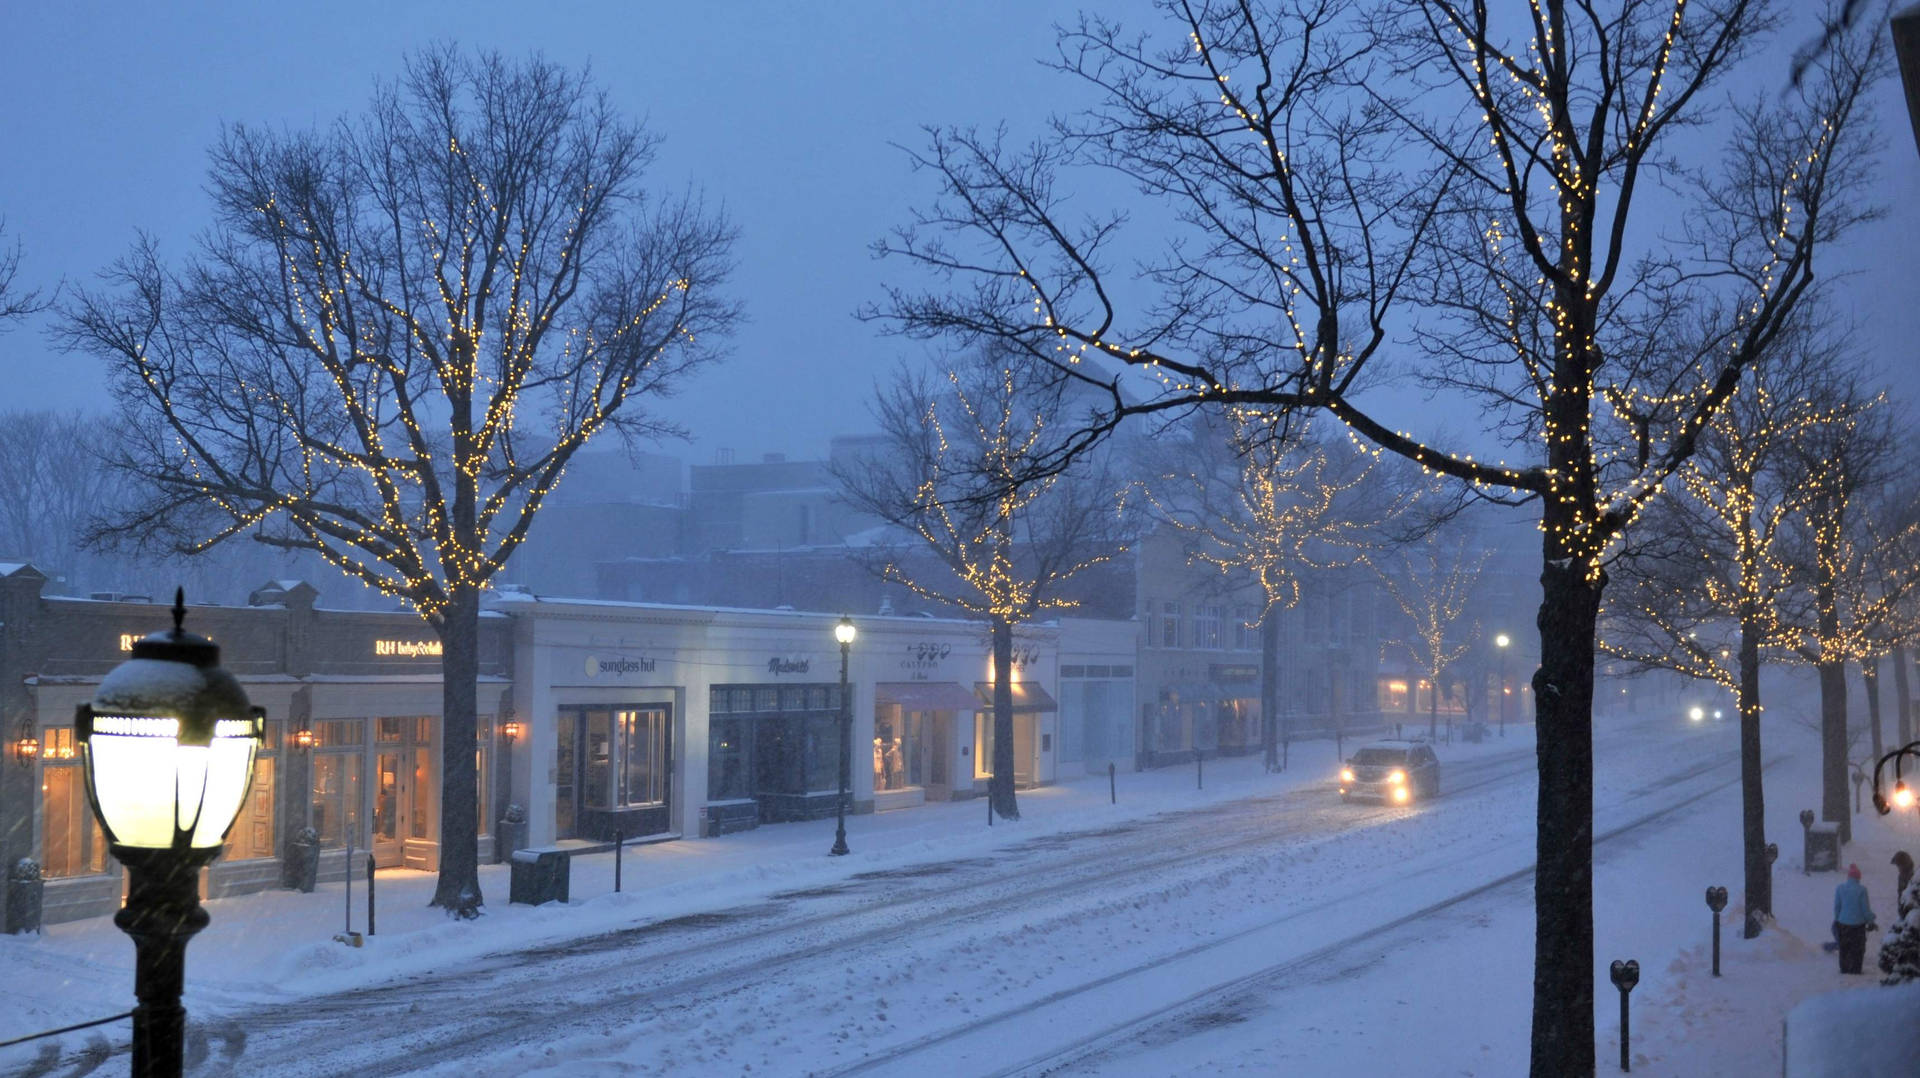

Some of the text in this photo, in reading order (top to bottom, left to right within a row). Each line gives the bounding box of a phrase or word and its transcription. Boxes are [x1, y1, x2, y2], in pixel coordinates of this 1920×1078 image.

[376, 640, 396, 655] RH
[600, 657, 656, 677] sunglass hut
